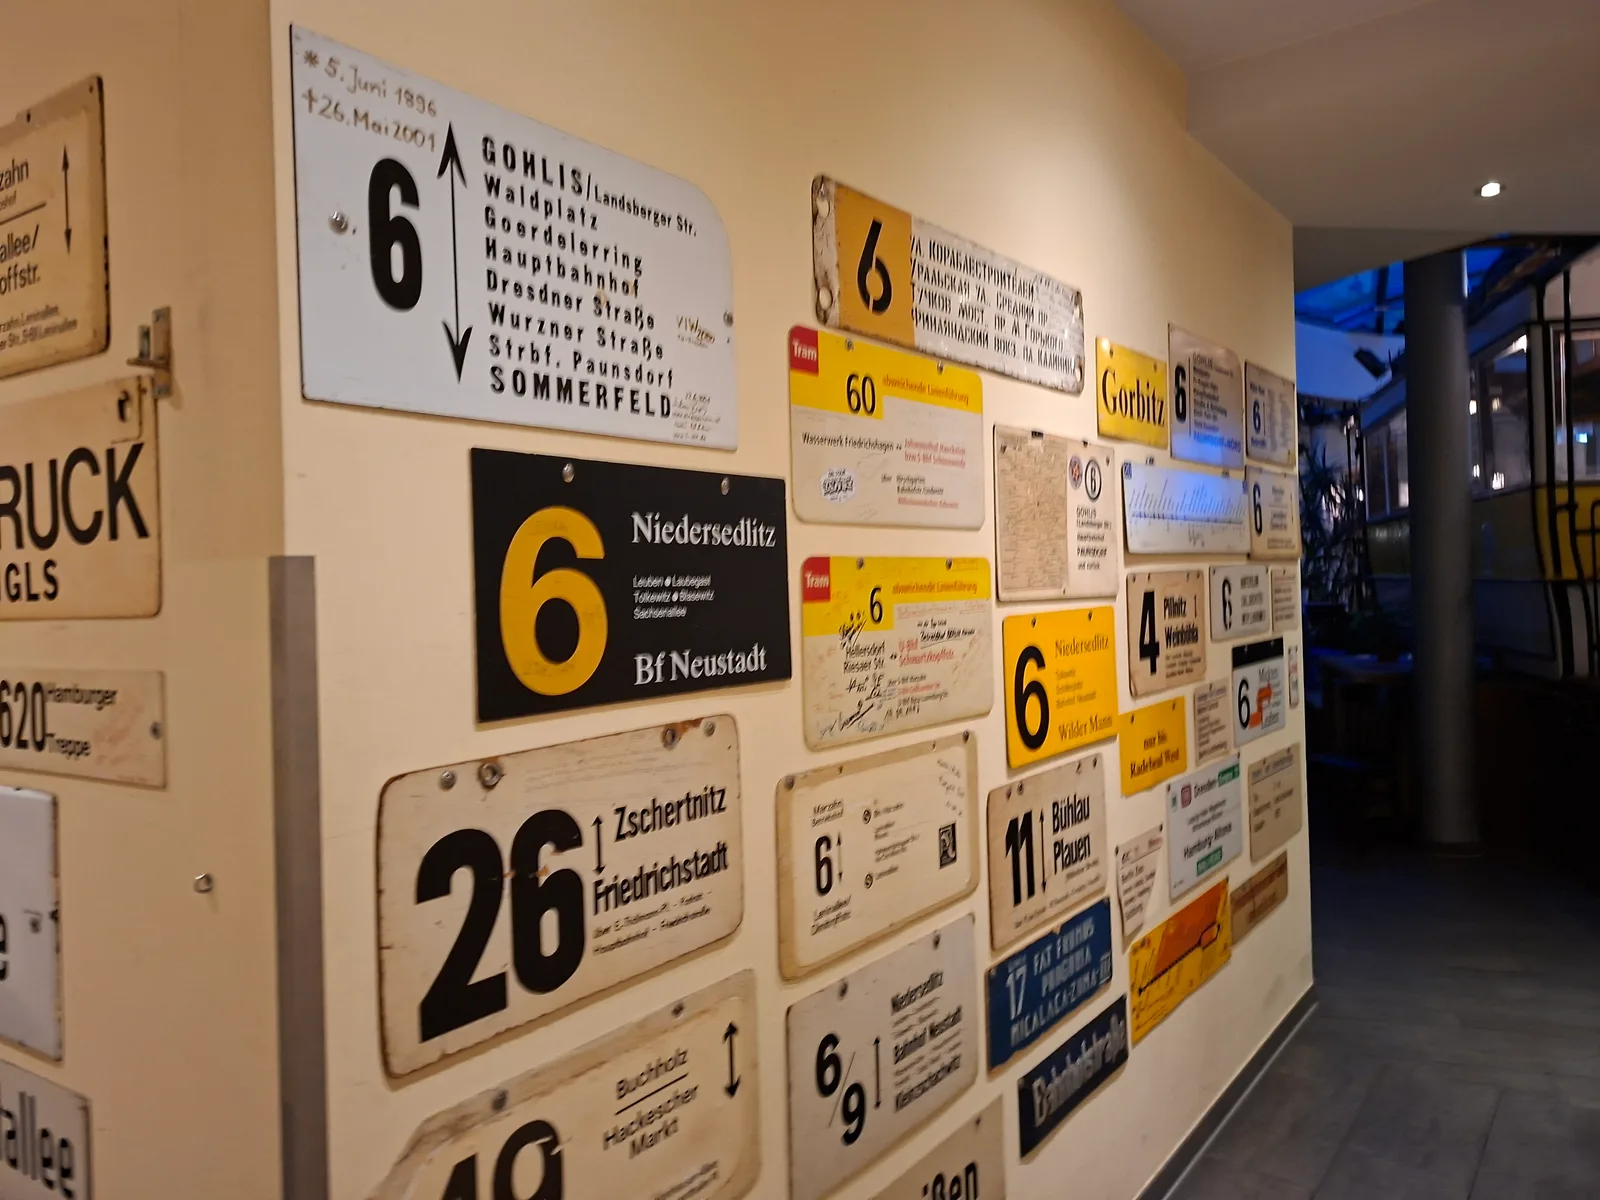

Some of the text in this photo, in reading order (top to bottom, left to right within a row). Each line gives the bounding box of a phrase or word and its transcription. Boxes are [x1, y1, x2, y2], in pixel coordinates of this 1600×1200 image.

[347, 66, 388, 97] Juni
[395, 86, 437, 118] 1896
[484, 173, 600, 231] Waldplatz
[676, 217, 698, 237] Str.
[368, 158, 423, 313] 6
[484, 206, 644, 277] Goerdelerring
[485, 236, 641, 299] Hauptbahnhof
[857, 218, 893, 316] 6
[486, 269, 656, 332] Dresdner Straße
[488, 302, 664, 362] Wurzner Straße
[792, 339, 817, 362] Tram
[489, 335, 674, 388] Strbf. Paunsdorf
[489, 365, 672, 419] SOMMERFELD
[846, 373, 876, 416] 60
[1102, 367, 1166, 427] Gorbitz
[1174, 365, 1187, 424] 6
[1252, 399, 1261, 435] 6
[802, 432, 844, 447] Wasserwerk
[844, 436, 894, 454] Friedrichshagen
[0, 441, 151, 551] RUCK
[1252, 482, 1263, 537] 6
[630, 511, 777, 548] Niedersedlitz
[0, 559, 60, 603] GLS
[499, 505, 608, 696] 6
[632, 589, 715, 604] Tolkewitz Blasewitz
[805, 571, 829, 589] Tram
[869, 586, 884, 624] 6
[1054, 634, 1110, 659] Niedersedlitz
[1139, 590, 1160, 676] 4
[633, 643, 768, 687] Bf Neustadt
[0, 679, 47, 753] 620
[46, 681, 118, 710] Hamburger
[1014, 645, 1050, 750] 6
[1238, 678, 1250, 730] 6
[1058, 720, 1087, 743] Wilder
[613, 784, 728, 842] Zschertnitz
[1052, 794, 1090, 836] Bühlau
[592, 841, 730, 916] Friedrichstadt
[815, 835, 833, 897] 6
[1005, 809, 1035, 908] 11
[1053, 833, 1091, 876] Plauen
[415, 809, 584, 1043] 26
[1005, 965, 1028, 1021] 17
[615, 1047, 689, 1101] Buchholz
[0, 1090, 76, 1200] allee
[603, 1084, 700, 1152] Hackescher
[629, 1117, 680, 1160] Markt
